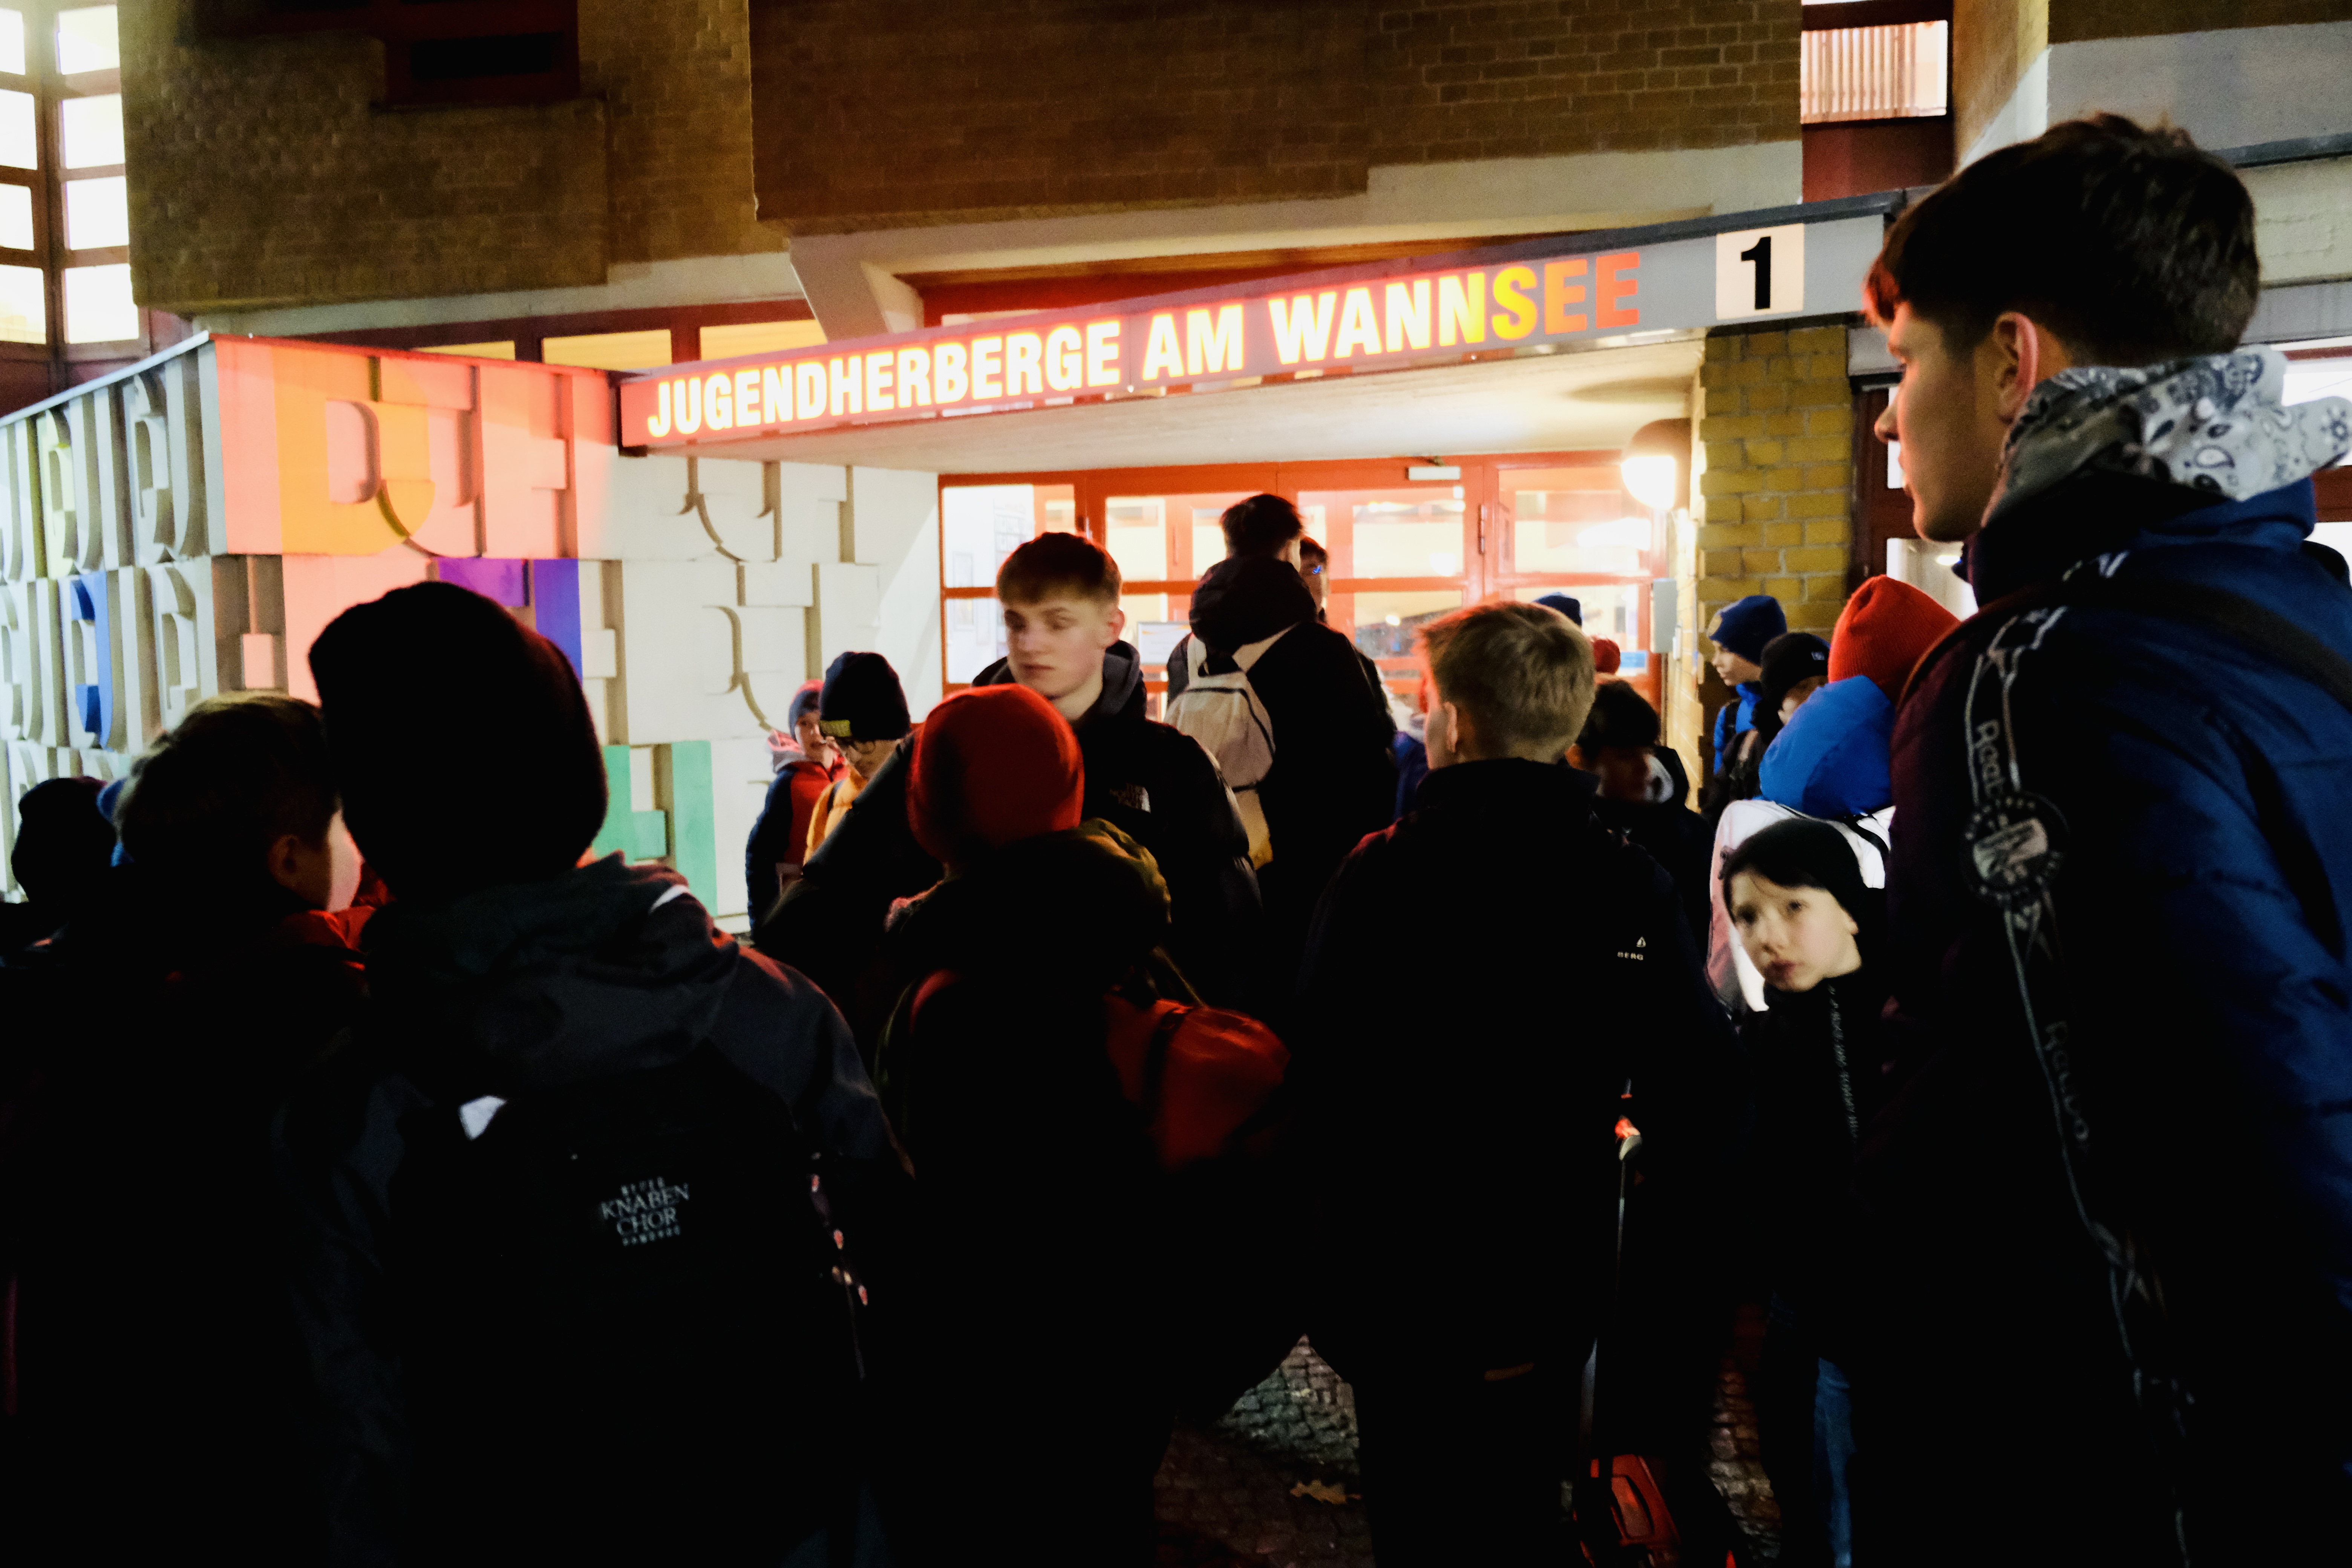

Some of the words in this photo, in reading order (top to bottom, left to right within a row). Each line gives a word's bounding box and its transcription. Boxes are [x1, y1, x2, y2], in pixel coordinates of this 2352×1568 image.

[1741, 236, 1771, 310] 1
[647, 320, 1121, 437] JUGENDHERBERGE
[1142, 305, 1243, 381] AM
[1269, 252, 1640, 365] WANNSEE
[601, 1182, 690, 1220] KNABEN
[616, 1206, 677, 1236] CHOR
